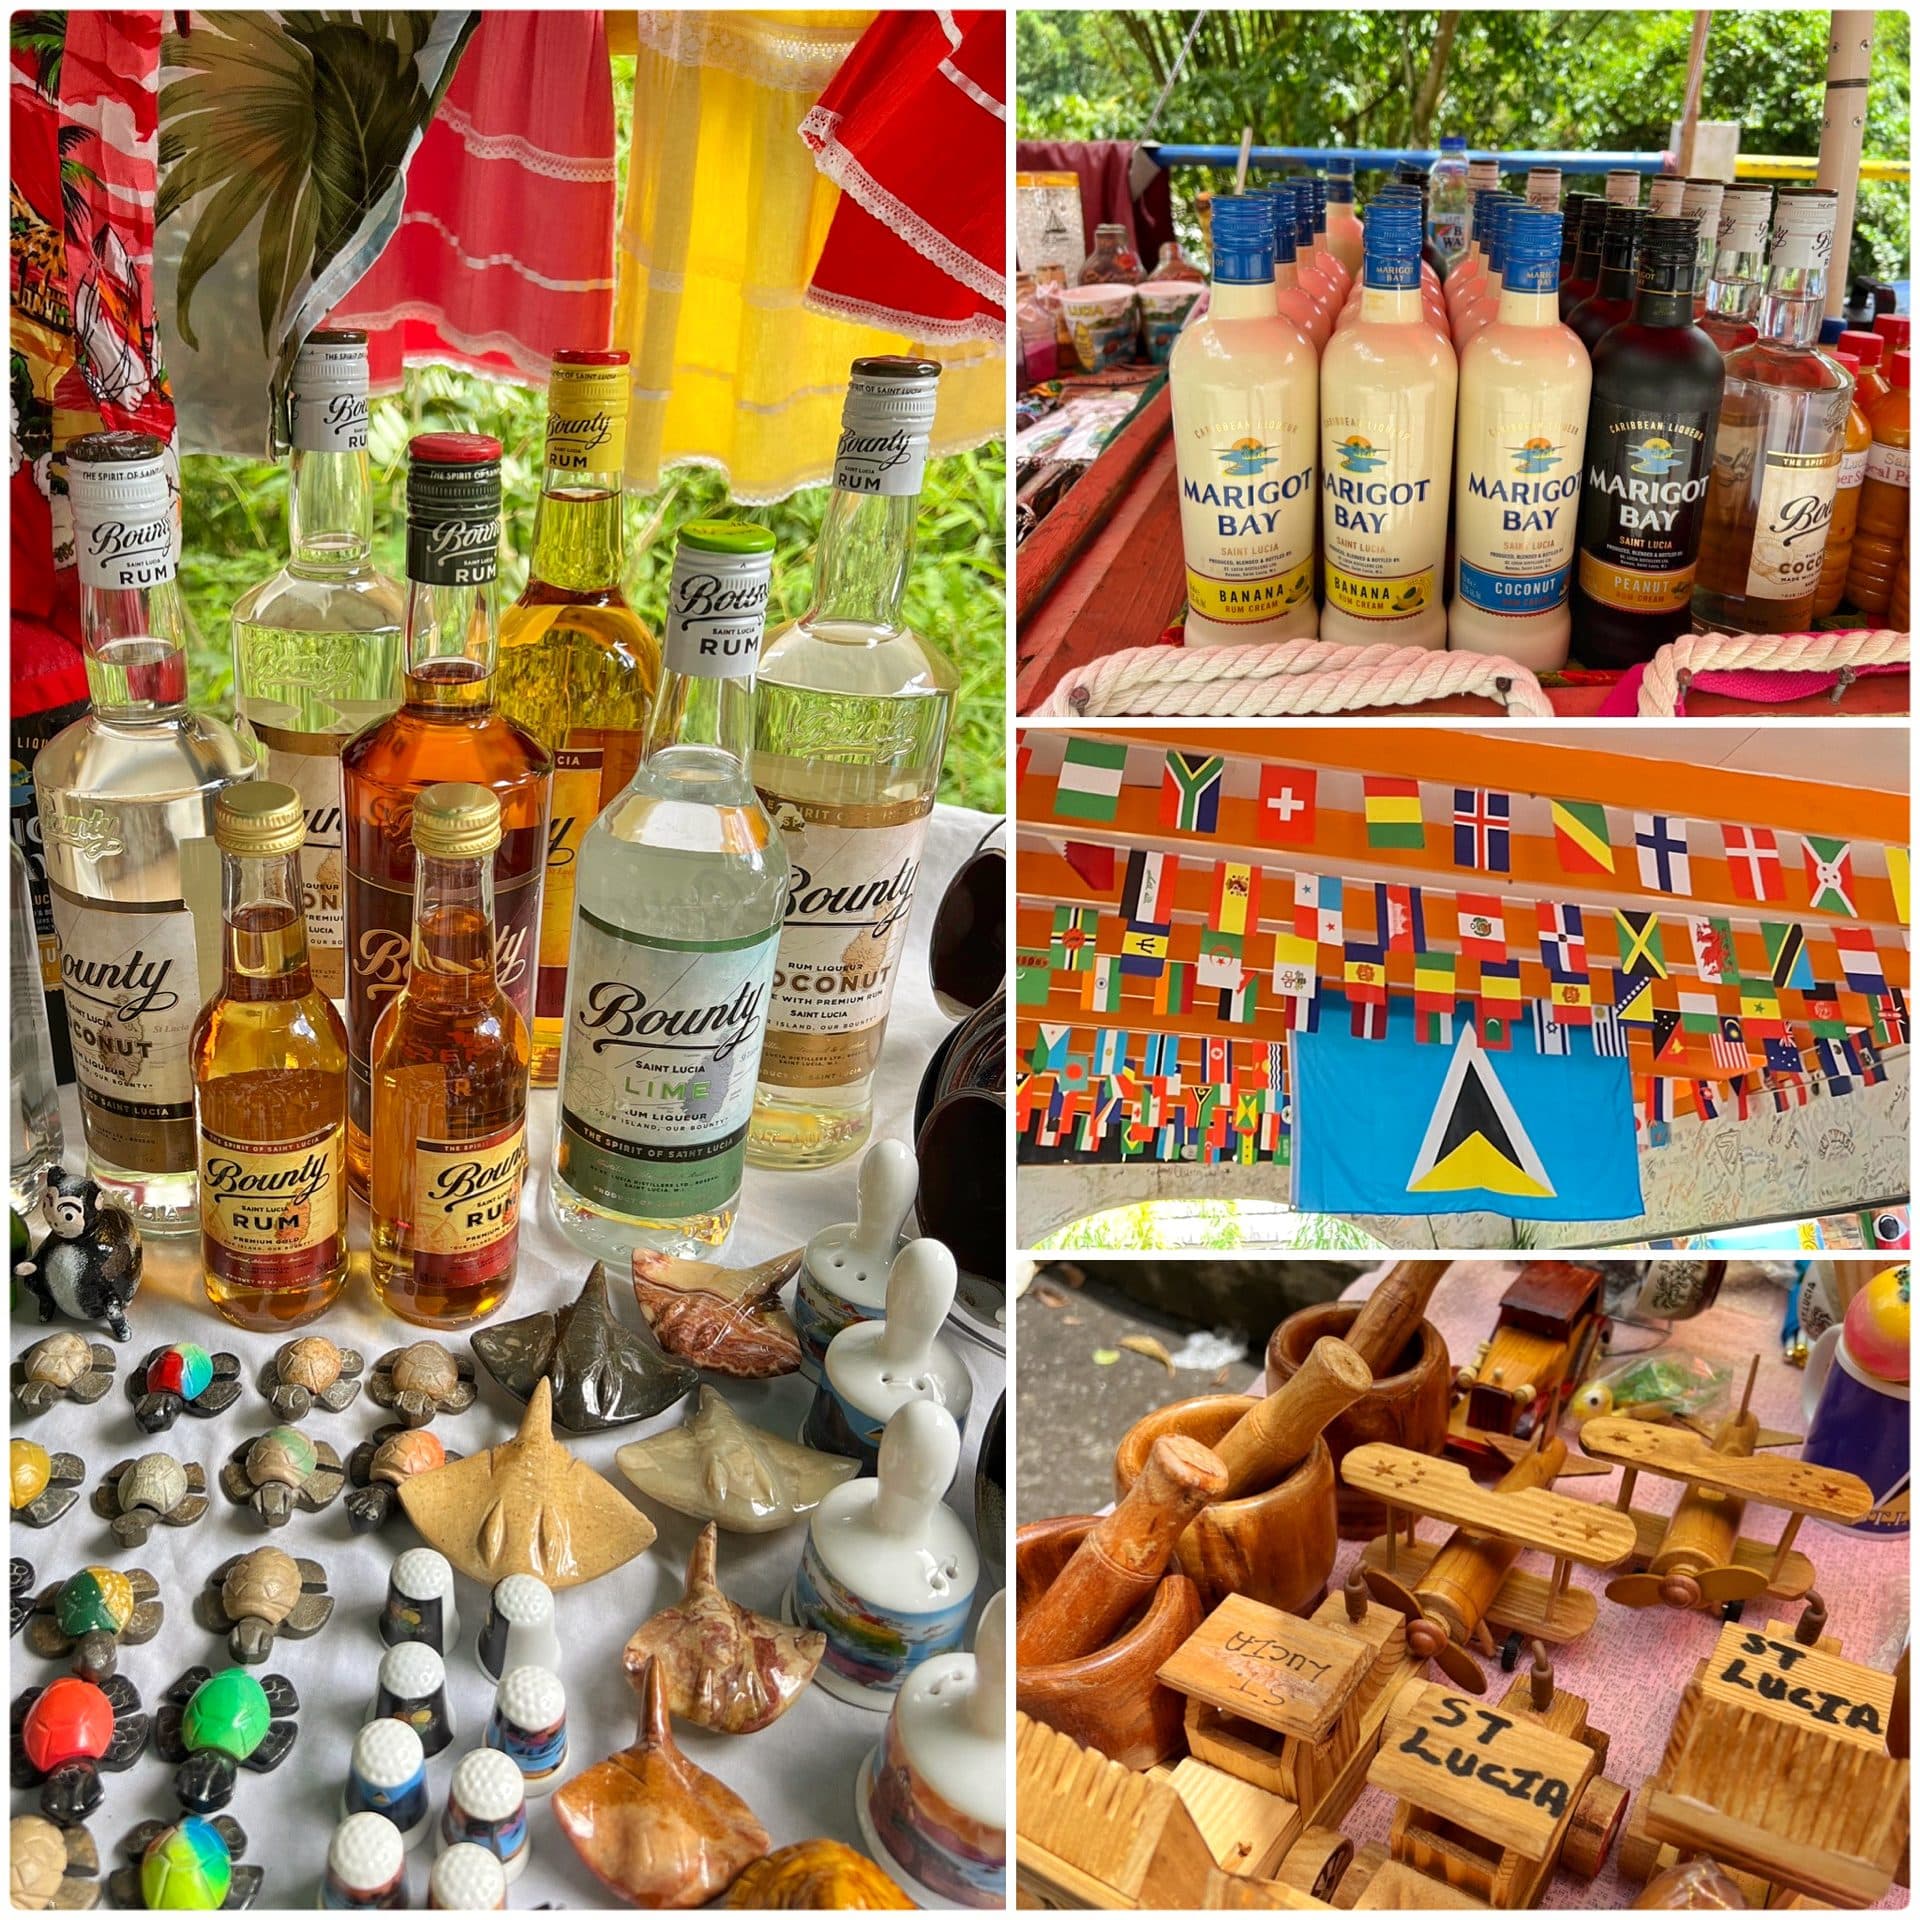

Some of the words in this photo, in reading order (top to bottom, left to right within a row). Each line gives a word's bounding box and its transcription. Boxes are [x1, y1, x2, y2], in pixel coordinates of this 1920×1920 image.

[1609, 420, 1663, 434] CARIBBEAN
[1668, 423, 1704, 442] LIQUEUR
[549, 453, 588, 468] RUM
[1783, 458, 1801, 467] THE
[82, 472, 96, 480] THE
[98, 472, 123, 480] SPIRIT
[127, 471, 138, 480] OF
[430, 471, 445, 480] THE
[446, 471, 472, 480] SPIRIT
[838, 473, 881, 491] RUM
[1184, 467, 1312, 509] MARIGOT
[1469, 471, 1583, 505] MARIGOT
[1589, 465, 1710, 505] MARIGOT
[1217, 510, 1281, 536] BAY
[1334, 504, 1388, 535] BAY
[1503, 507, 1560, 531] BAY
[1620, 505, 1680, 532] BAY
[1221, 547, 1248, 556] SAINT
[1252, 543, 1279, 555] LUCIA
[1532, 540, 1555, 551] LUCIA
[1620, 536, 1645, 549] SAINT
[1648, 540, 1673, 549] LUCIA
[120, 565, 167, 585] RUM
[455, 565, 497, 583] RUM
[1219, 584, 1284, 603] BANANA
[1334, 576, 1389, 600] BANANA
[1495, 578, 1556, 596] COCONUT
[1615, 576, 1669, 593] PEANUT
[1225, 604, 1245, 613] RUM
[1248, 601, 1279, 612] CREAM
[1356, 599, 1384, 610] CREAM
[700, 636, 758, 656] RUM
[308, 926, 335, 935] LUCIA
[310, 938, 328, 946] OUR
[788, 962, 812, 971] RUM
[816, 964, 863, 973] LIQUEUR
[782, 995, 812, 1005] WITH
[816, 995, 864, 1006] PREMIUM
[866, 989, 883, 1000] RUM
[87, 1012, 113, 1029] LUCIA
[580, 981, 766, 1062] Bounty
[790, 1009, 819, 1019] SAINT
[821, 1011, 848, 1019] LUCIA
[776, 1021, 815, 1032] ISLAND,
[85, 1056, 126, 1078] LIQUEUR
[635, 1059, 671, 1074] SAINT
[672, 1064, 706, 1075] LUCIA
[623, 1076, 712, 1101] LIME
[101, 1098, 130, 1114] SAINT
[134, 1104, 169, 1117] LUCIA
[652, 1110, 708, 1122] LIQUEUR
[621, 1117, 661, 1132] ISLAND,
[665, 1124, 685, 1132] OUR
[223, 1140, 250, 1152] SPIRIT
[252, 1144, 265, 1153] OF
[267, 1144, 293, 1152] SAINT
[296, 1136, 320, 1149] LUCIA
[583, 1127, 603, 1143] THE
[605, 1139, 643, 1156] SPIRIT
[648, 1149, 665, 1159] OF
[668, 1149, 704, 1159] SAINT
[707, 1138, 736, 1155] LUCIA
[203, 1152, 331, 1206] Bounty
[241, 1205, 264, 1213] SAINT
[266, 1205, 289, 1213] LUCIA
[476, 1196, 497, 1208] SAINT
[232, 1212, 300, 1232] RUM
[232, 1235, 273, 1245] PREMIUM
[275, 1236, 301, 1246] GOLD
[466, 1227, 501, 1242] PREMIUM
[1225, 1631, 1332, 1683] LUCIA
[1739, 1632, 1807, 1671] ST
[1720, 1658, 1884, 1735] LUCIA
[1432, 1697, 1514, 1745] ST
[1400, 1727, 1571, 1819] LUCIA
